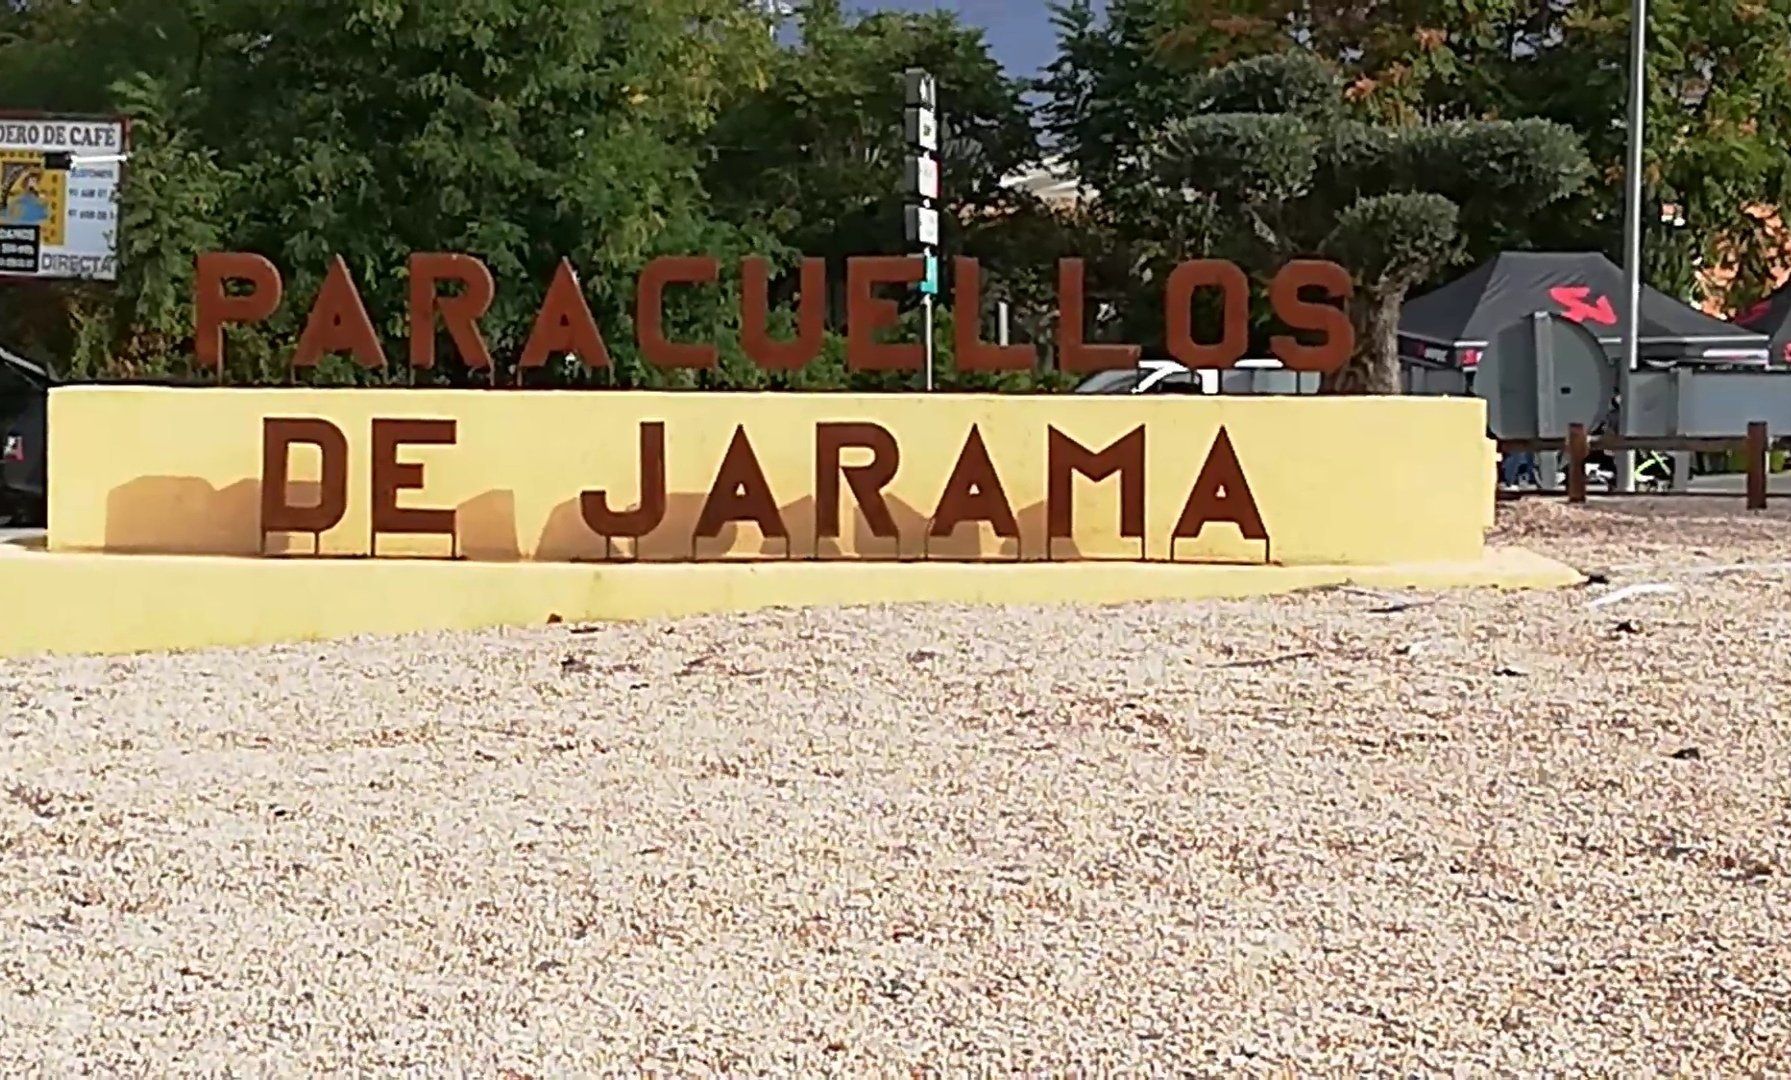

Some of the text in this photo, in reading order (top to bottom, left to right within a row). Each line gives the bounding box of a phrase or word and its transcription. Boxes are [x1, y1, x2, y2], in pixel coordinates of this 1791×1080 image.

[43, 126, 66, 145] DE
[194, 252, 1356, 372] PARACUELLOS
[262, 417, 1270, 538] DE JARAMA
